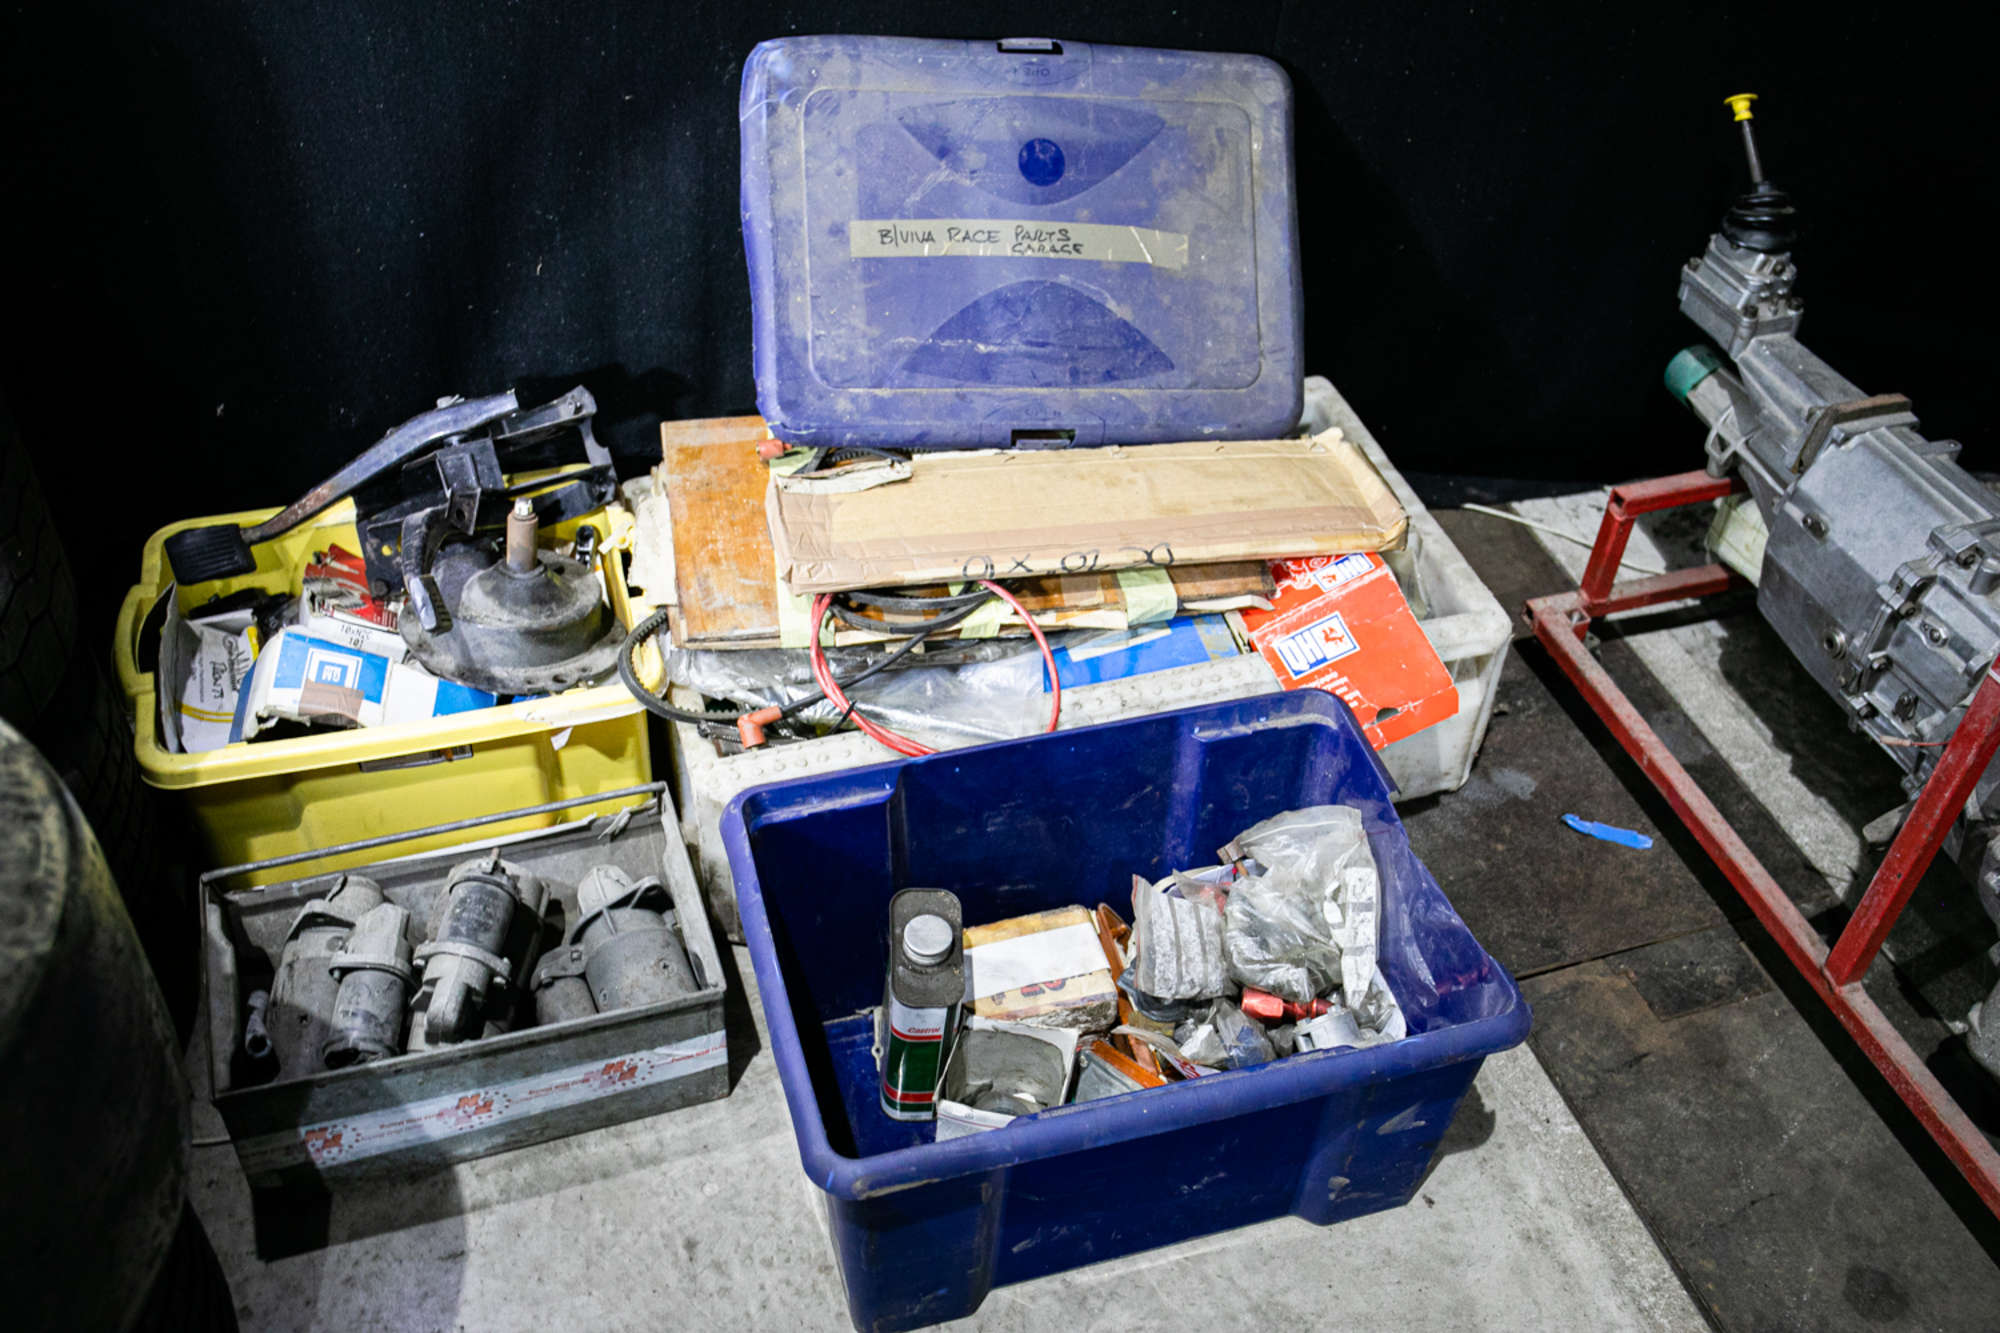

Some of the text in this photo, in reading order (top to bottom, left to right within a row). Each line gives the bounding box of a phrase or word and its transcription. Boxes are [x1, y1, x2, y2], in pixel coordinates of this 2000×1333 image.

[947, 227, 1001, 244] RACE
[1014, 224, 1072, 243] PARTS
[1011, 242, 1085, 255] GARAGE
